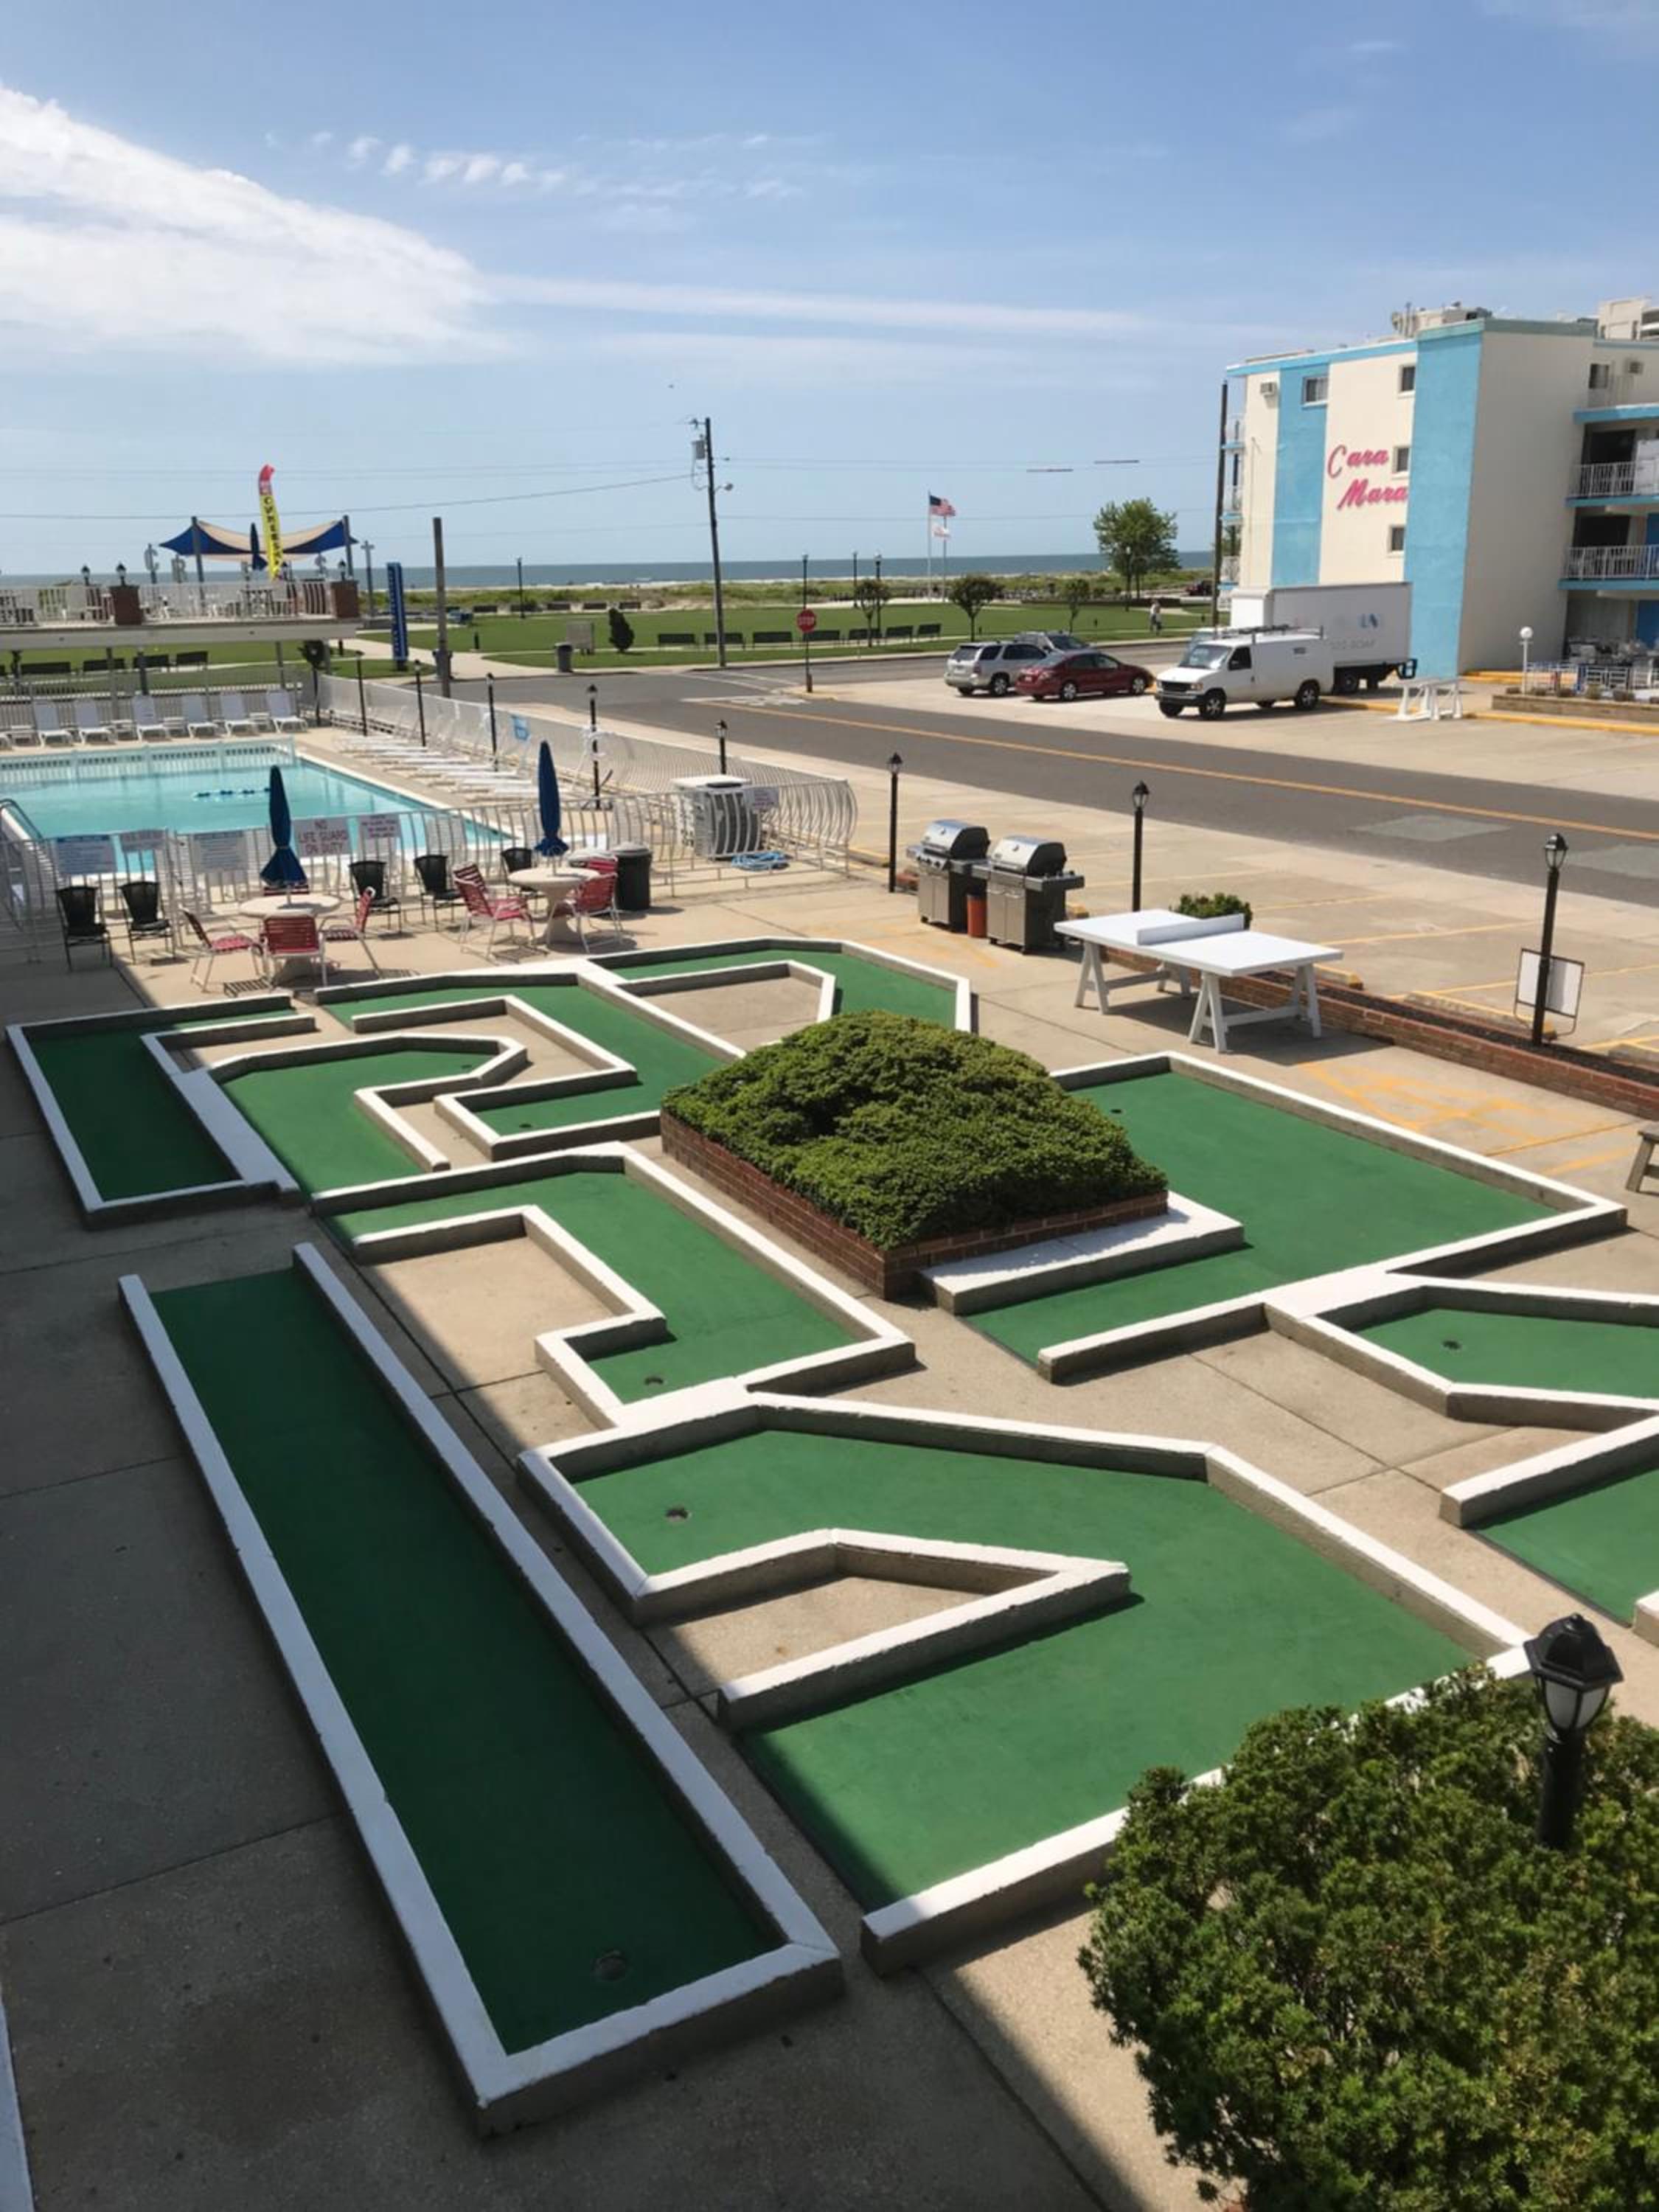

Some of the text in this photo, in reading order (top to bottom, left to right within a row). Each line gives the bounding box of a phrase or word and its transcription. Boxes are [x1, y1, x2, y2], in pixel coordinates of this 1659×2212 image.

[1327, 445, 1389, 479] Cara
[1337, 479, 1408, 511] Mara
[314, 819, 327, 830] NO
[299, 829, 348, 844] LIFE GUARD
[305, 841, 343, 854] ON DUTY
